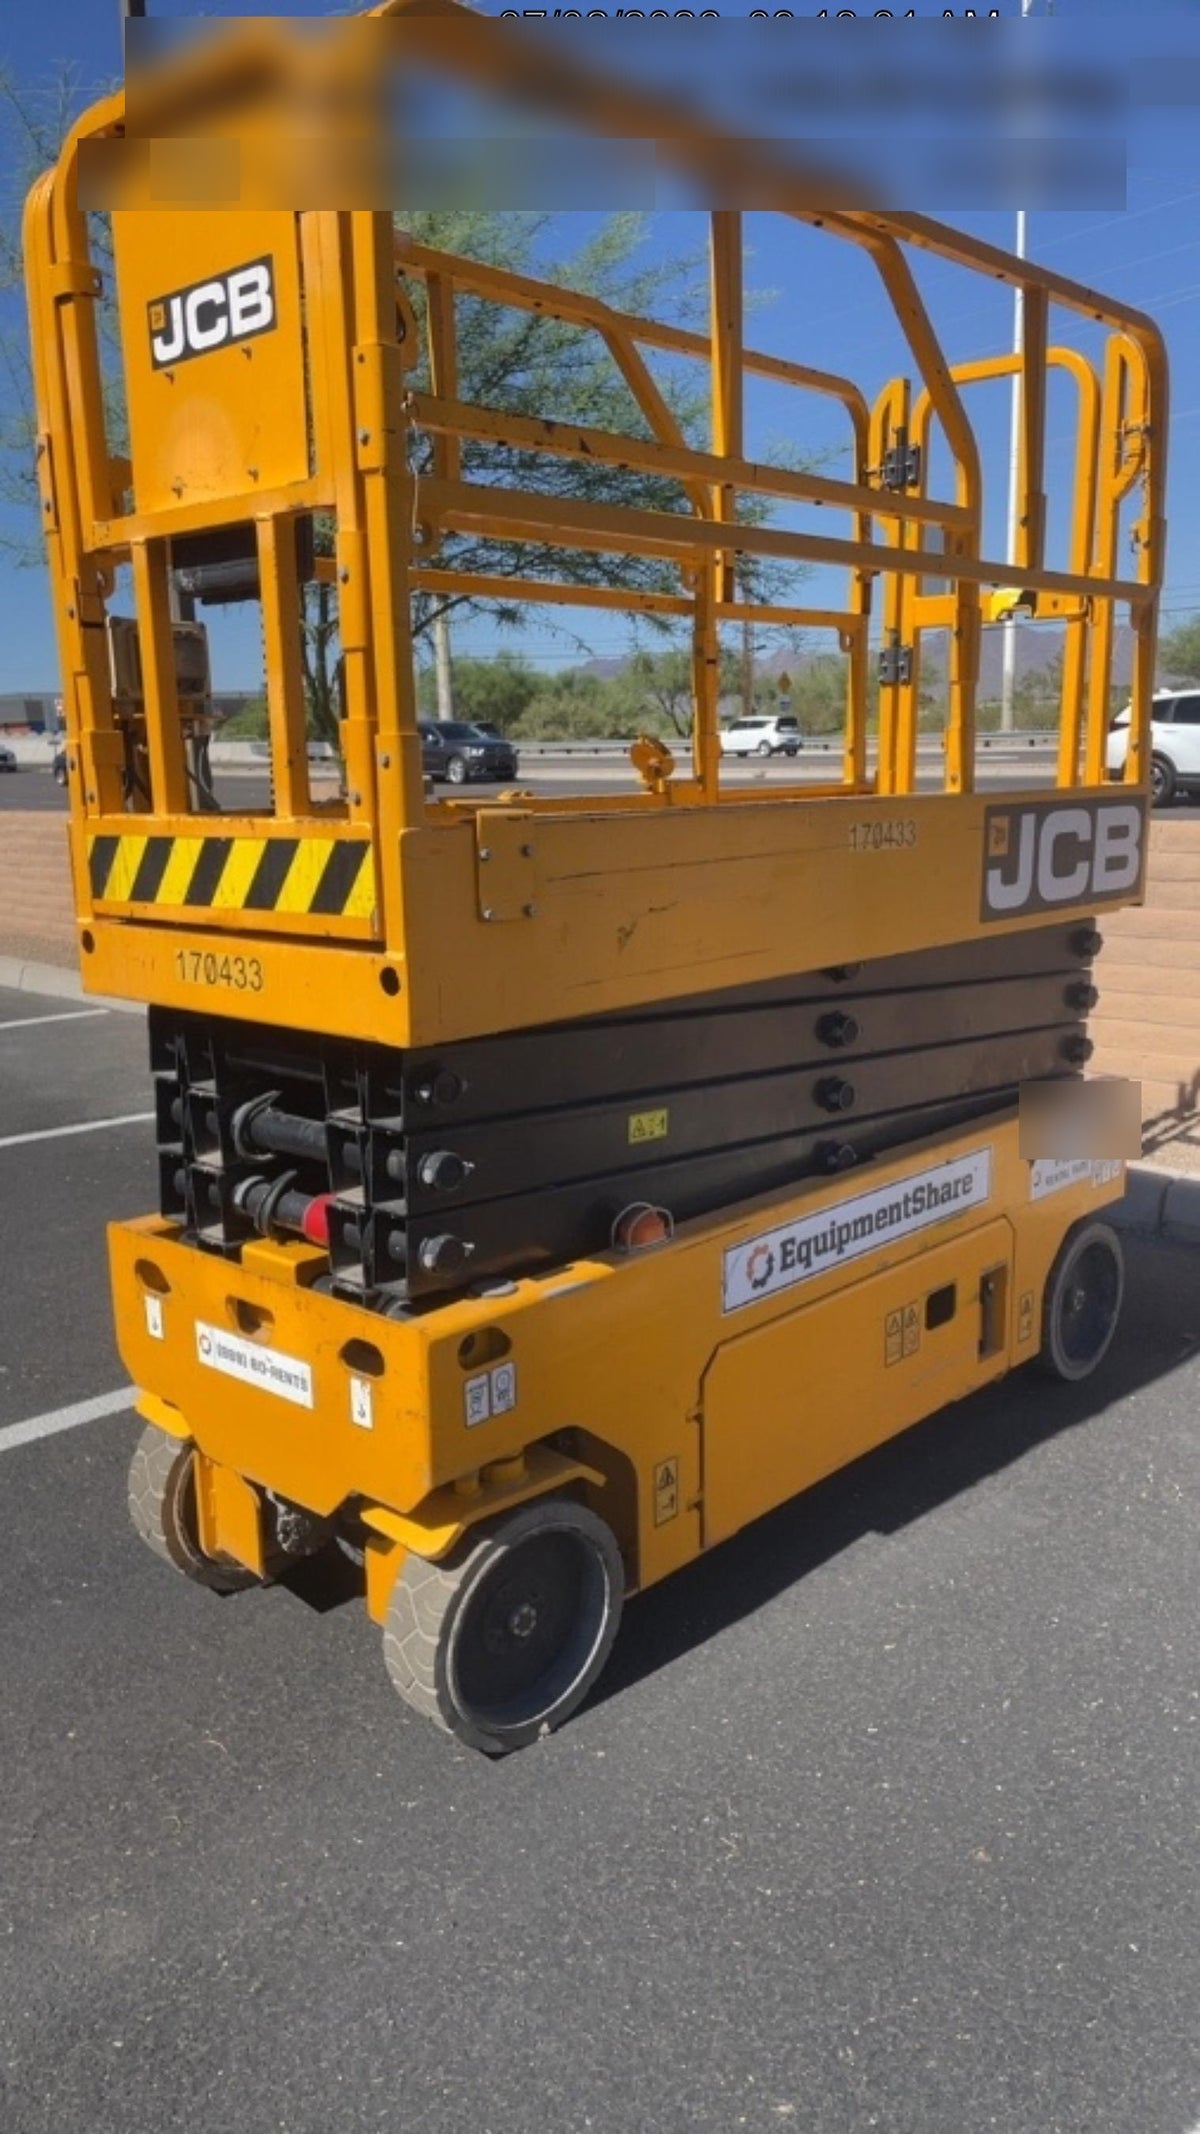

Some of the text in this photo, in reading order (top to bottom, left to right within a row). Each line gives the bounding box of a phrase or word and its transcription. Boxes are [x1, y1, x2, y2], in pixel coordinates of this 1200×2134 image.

[152, 264, 273, 362] JCB
[849, 819, 917, 851] 170433
[986, 805, 1142, 910] JCB
[176, 950, 263, 992] 170433
[779, 1172, 974, 1272] EquipmentShare
